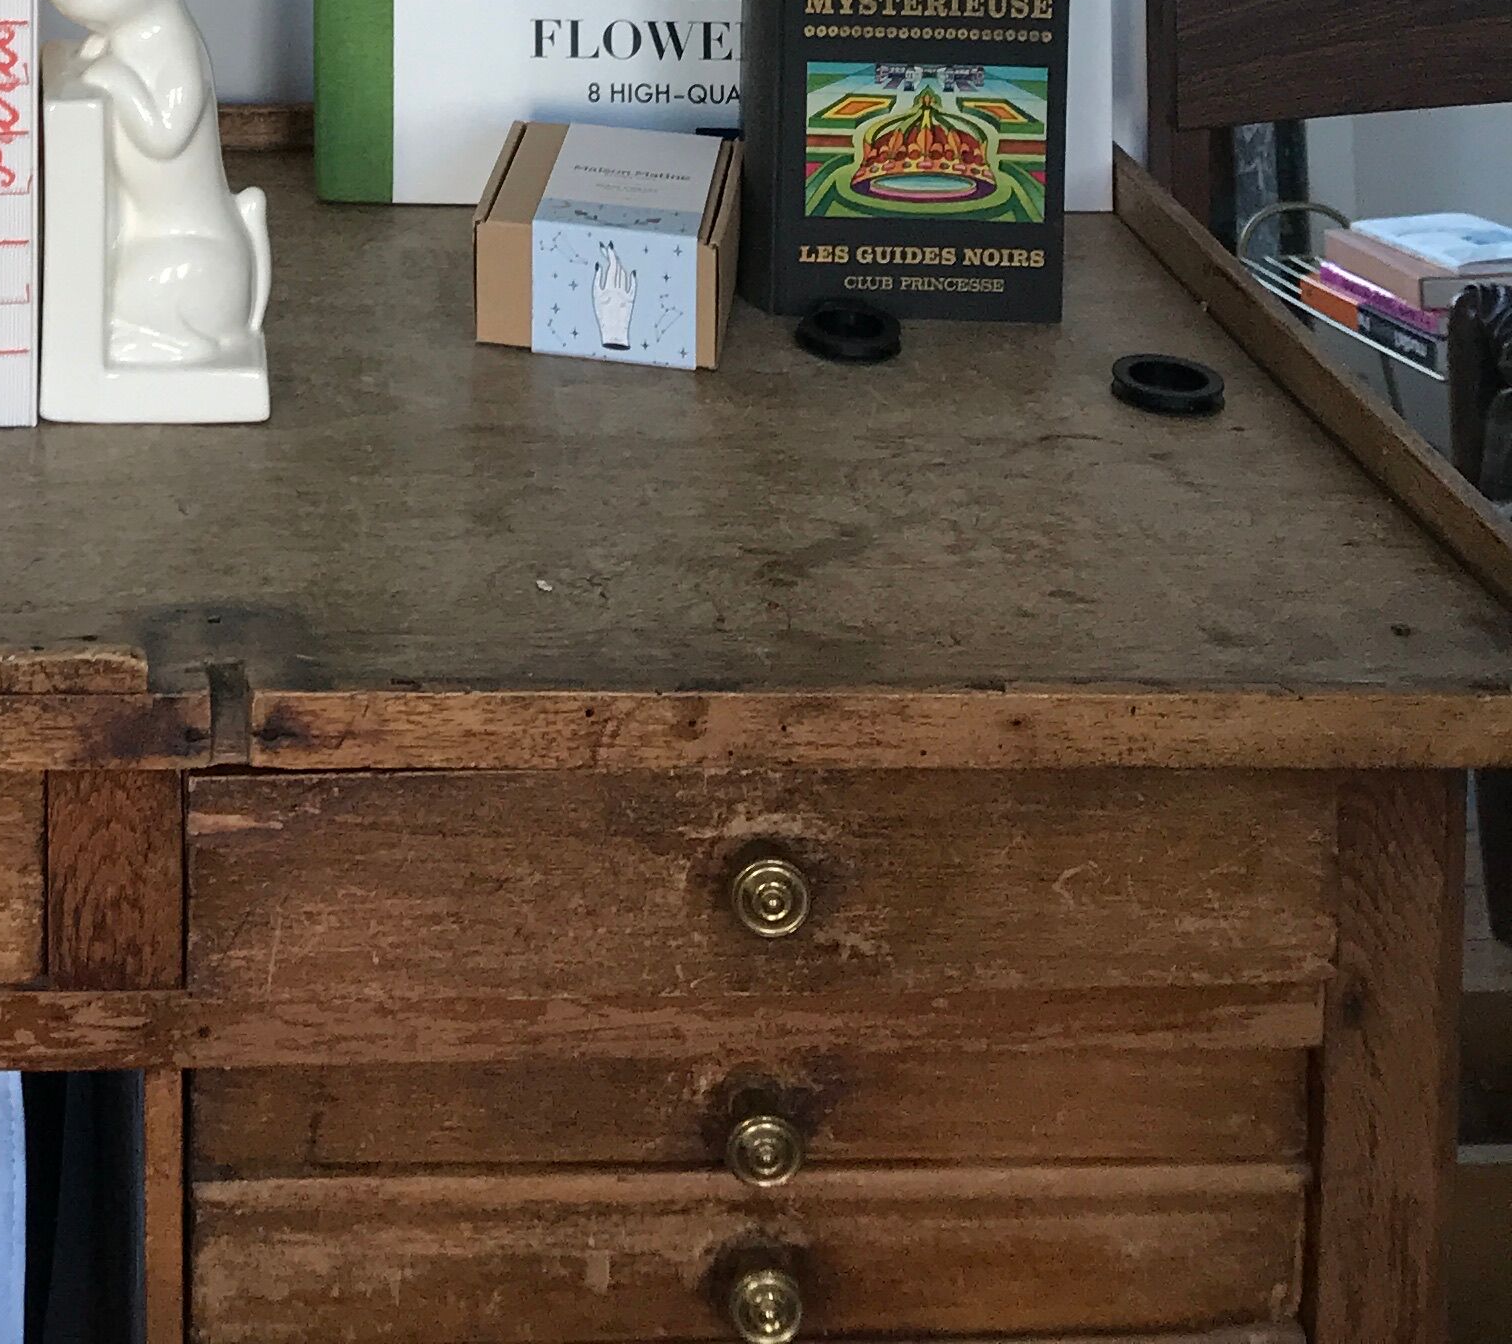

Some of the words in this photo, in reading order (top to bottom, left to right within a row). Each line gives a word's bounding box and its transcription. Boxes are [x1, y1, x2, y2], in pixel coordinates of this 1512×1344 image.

[530, 18, 743, 62] FLOWE
[588, 82, 601, 103] 8
[610, 83, 741, 104] HIGH-QUA
[798, 245, 849, 263] LES
[855, 245, 957, 266] GUIDES
[962, 248, 1045, 268] NOIRS
[843, 275, 893, 291] CLUB
[899, 276, 1005, 293] PRINCESSE
